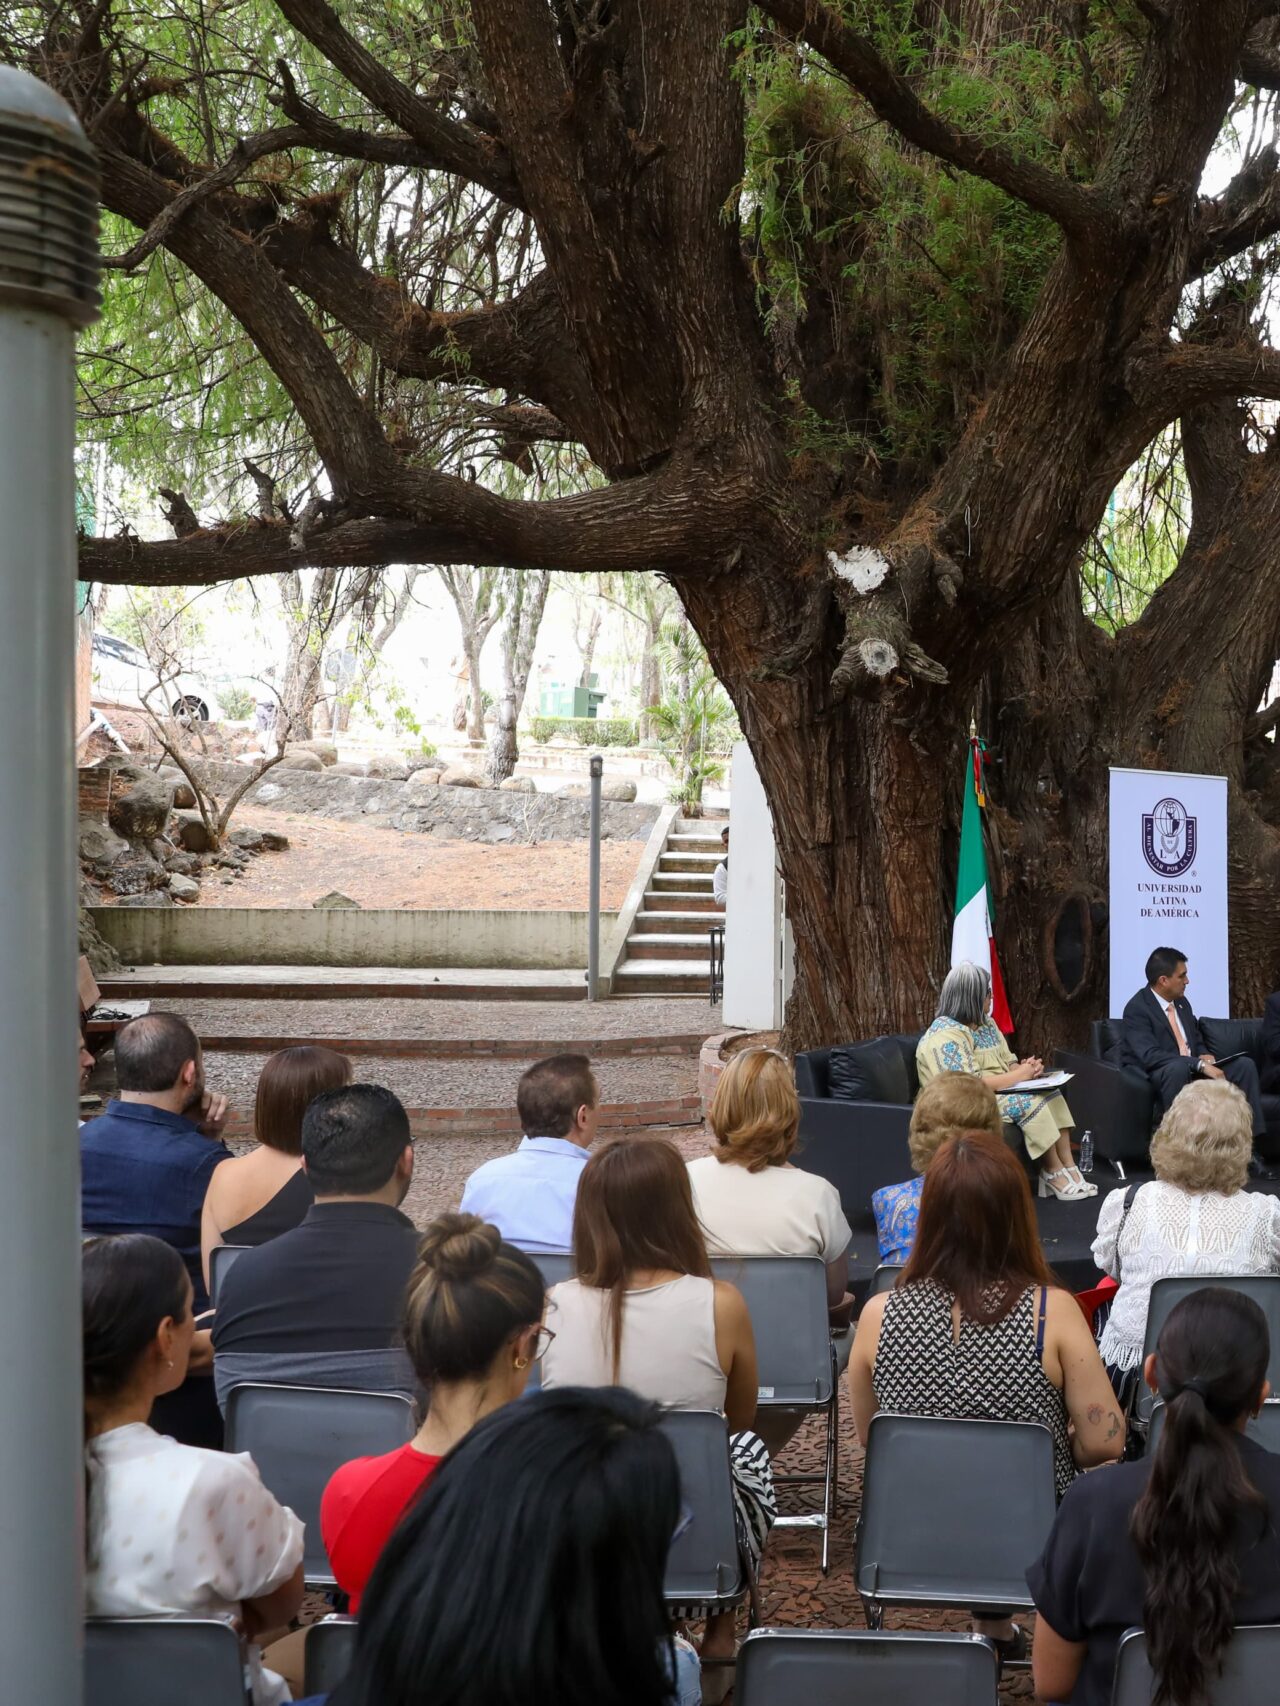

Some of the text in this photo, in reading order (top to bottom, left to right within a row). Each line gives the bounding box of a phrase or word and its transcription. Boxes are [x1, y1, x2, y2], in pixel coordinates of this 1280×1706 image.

[1146, 836, 1164, 870] BIENESTAR
[1180, 859, 1188, 867] LA
[1137, 883, 1202, 893] UNIVERSIDAD
[1152, 896, 1187, 905] LATINA
[1140, 906, 1200, 918] DE AMÉRICA
